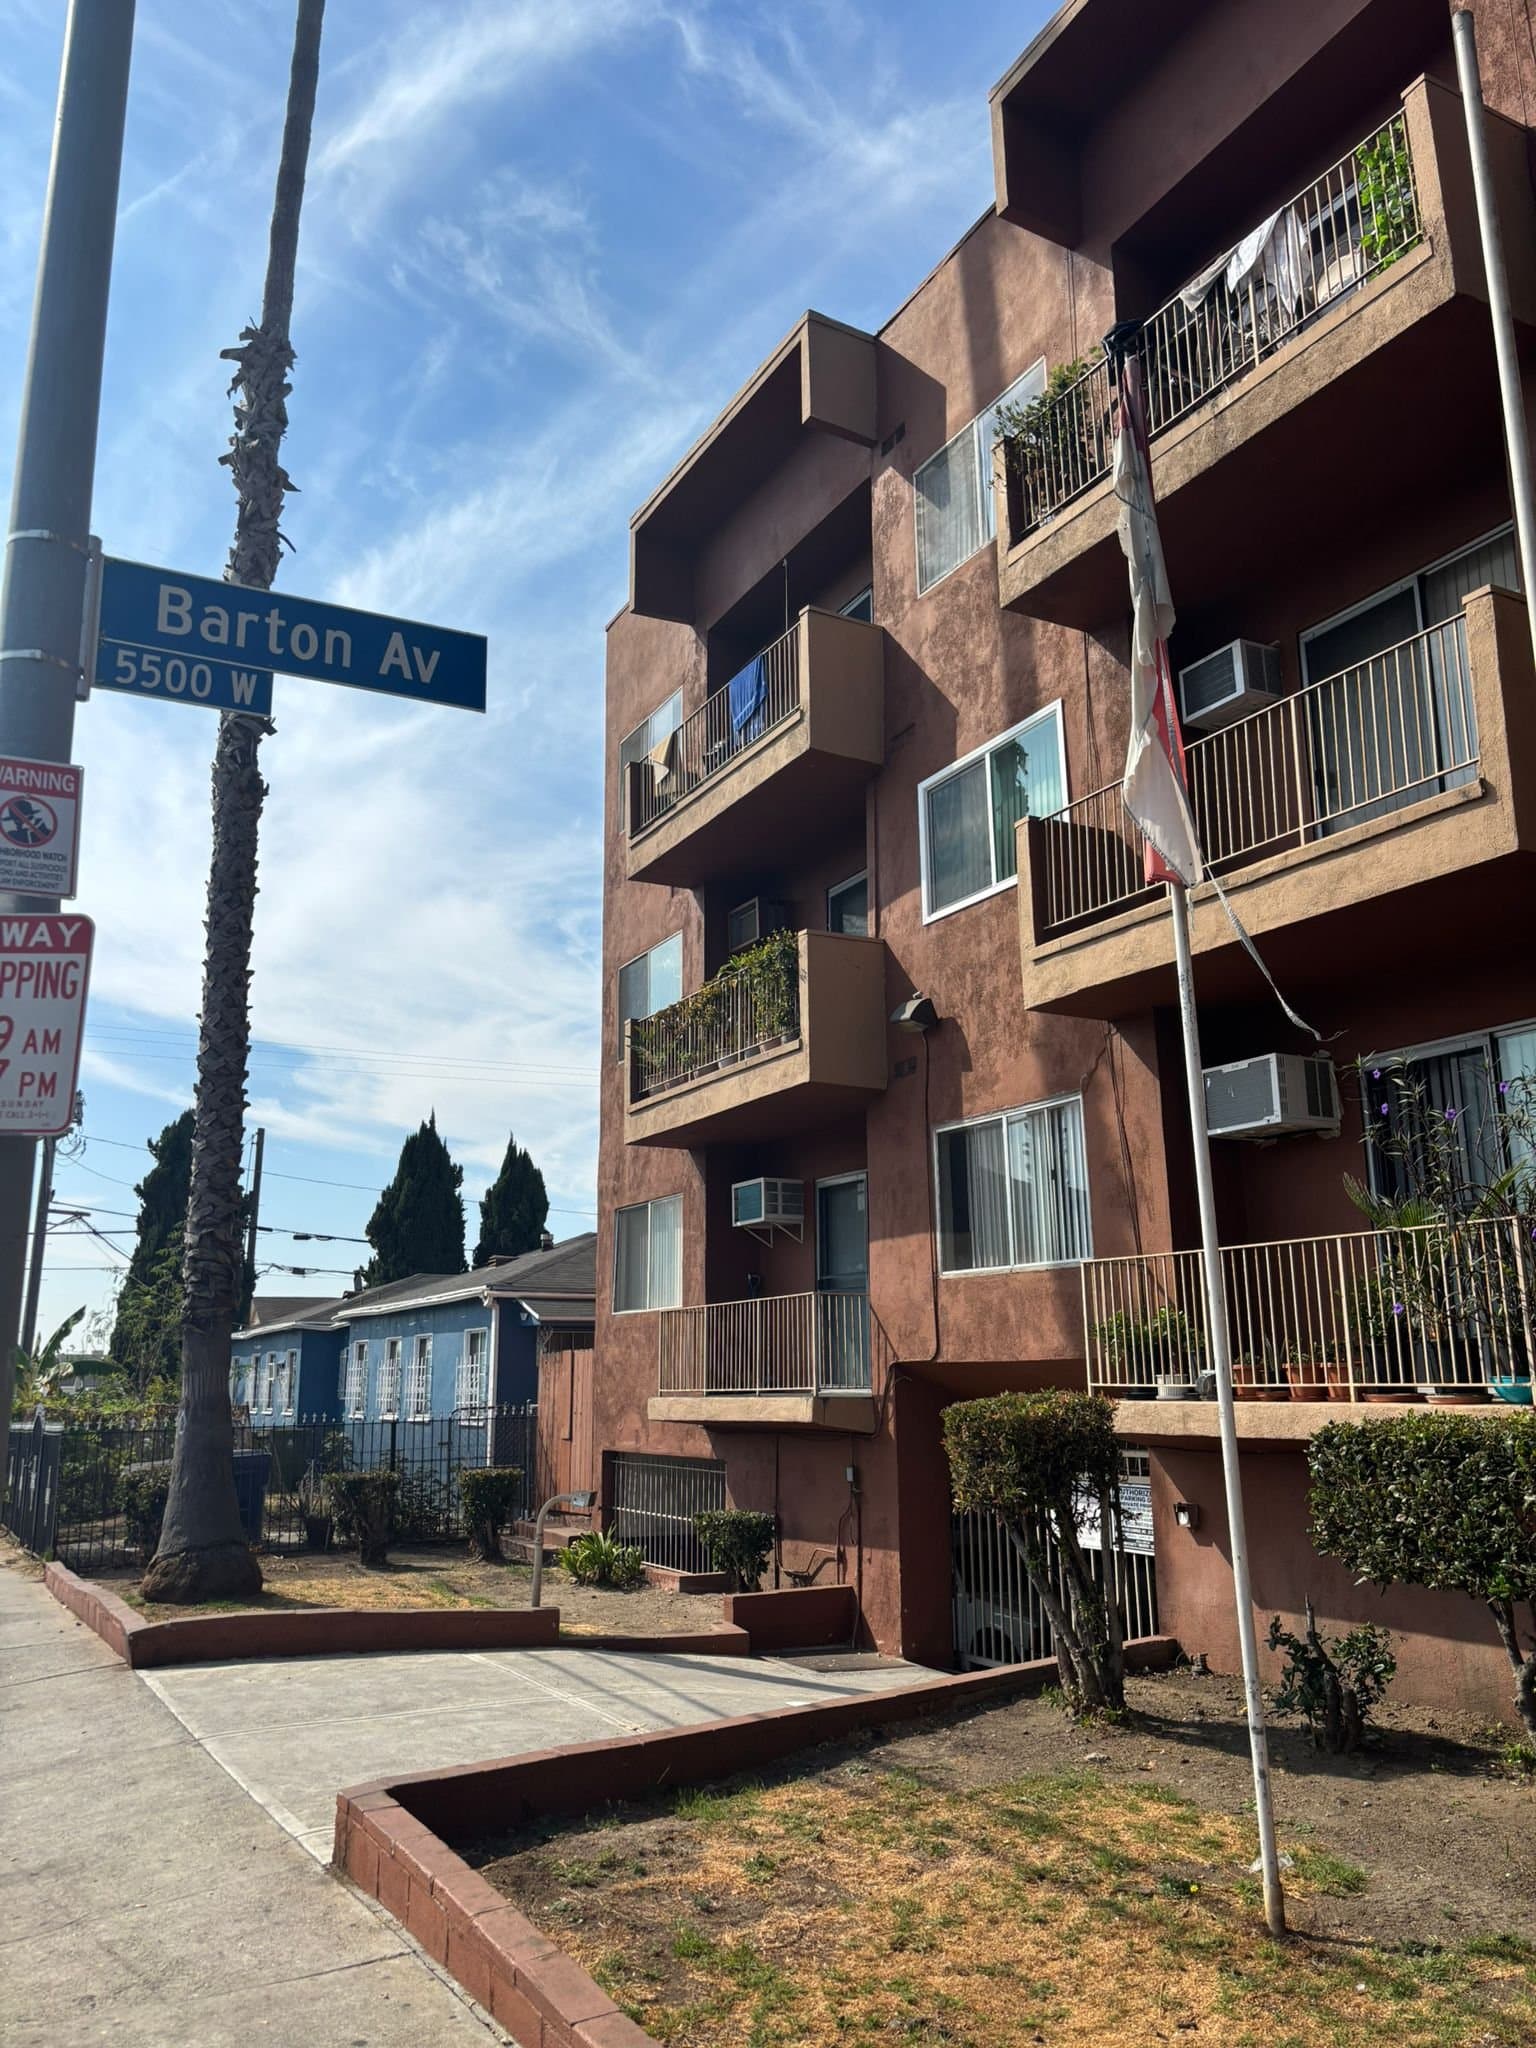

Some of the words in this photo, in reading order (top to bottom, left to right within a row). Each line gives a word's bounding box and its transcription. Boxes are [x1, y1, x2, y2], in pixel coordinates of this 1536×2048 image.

[157, 584, 352, 669] Barton
[378, 631, 441, 684] Av
[115, 649, 213, 699] 5500
[231, 670, 258, 706] W
[2, 921, 83, 948] WAY
[21, 1028, 62, 1055] AM
[18, 1071, 58, 1099] PM
